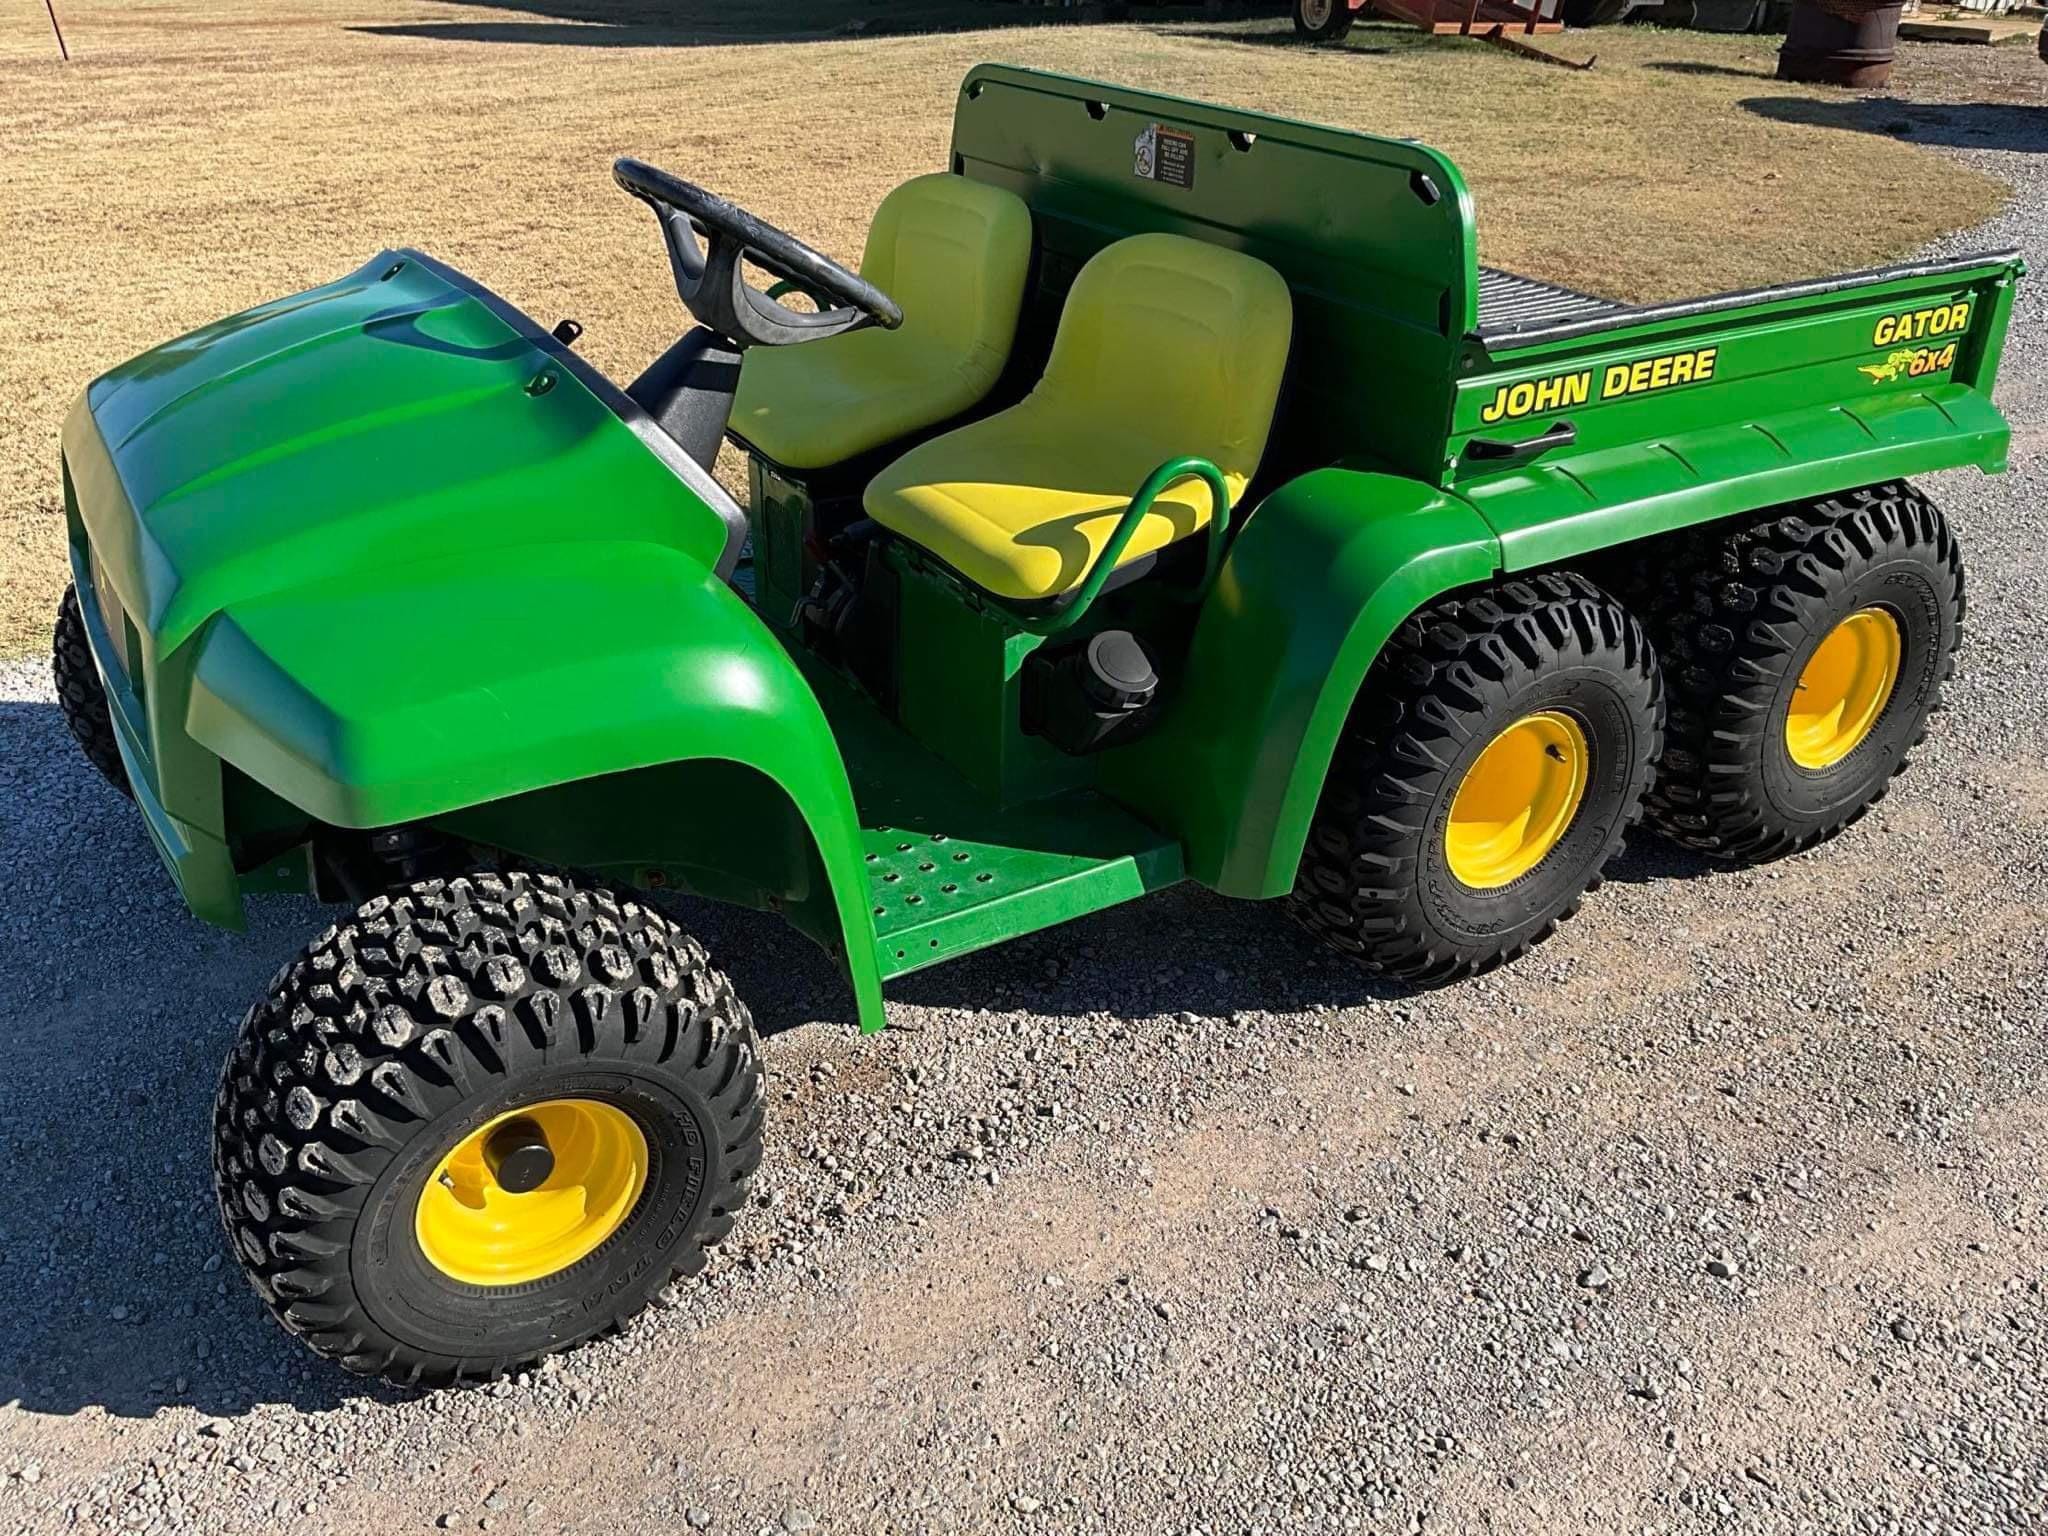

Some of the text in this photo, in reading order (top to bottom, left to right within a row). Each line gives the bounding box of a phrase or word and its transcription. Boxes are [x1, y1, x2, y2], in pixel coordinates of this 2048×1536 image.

[1873, 303, 1970, 346] GATOR
[1481, 348, 1717, 422] JOHN DEERE
[671, 1109, 701, 1147] HD
[656, 1156, 705, 1251] FIELD
